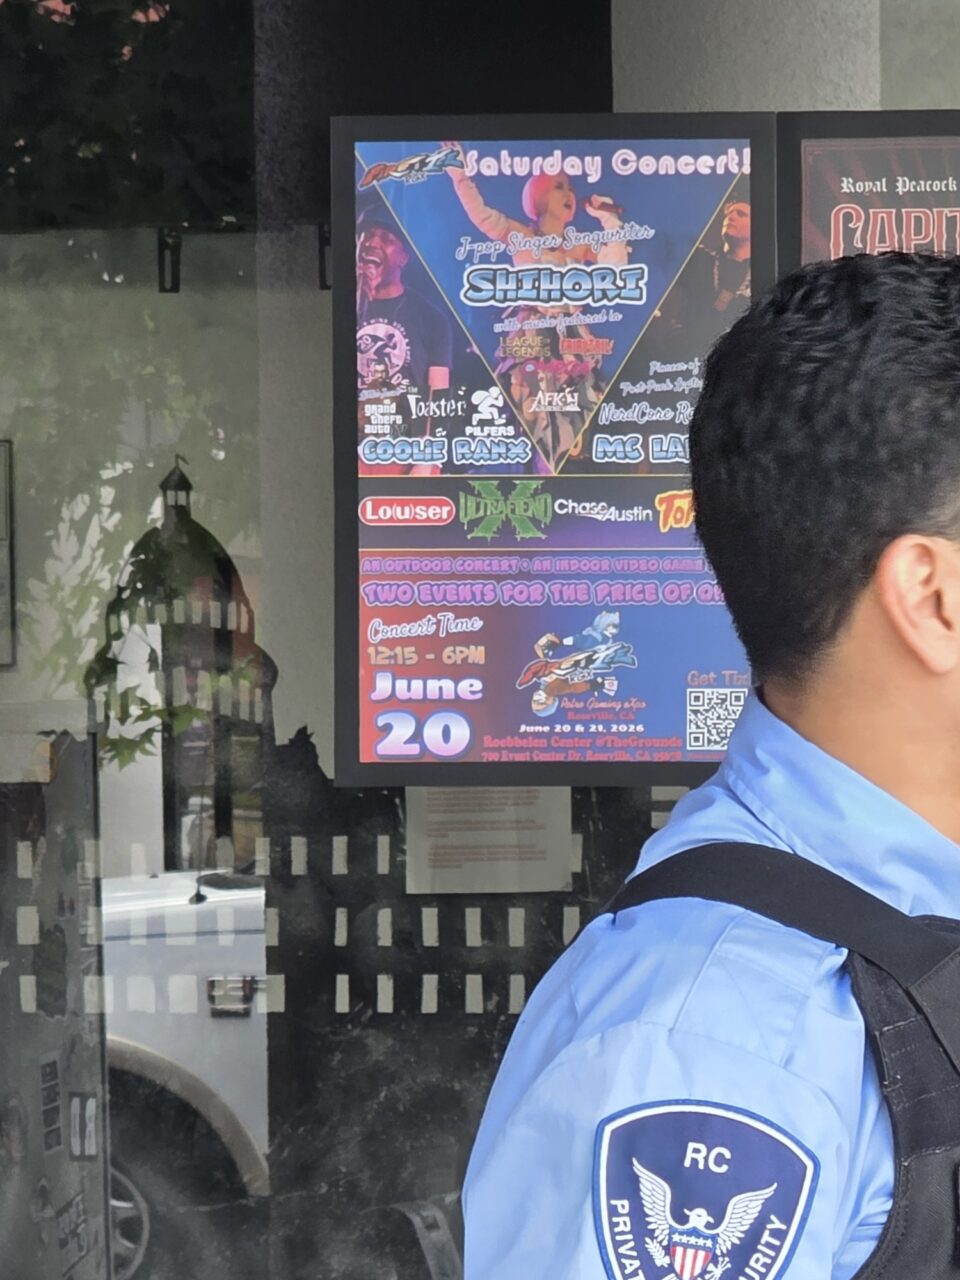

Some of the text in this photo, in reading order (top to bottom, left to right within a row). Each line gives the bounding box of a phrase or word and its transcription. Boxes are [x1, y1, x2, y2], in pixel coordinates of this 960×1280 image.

[463, 149, 601, 183] Saturday
[611, 147, 751, 176] Concert!
[841, 176, 887, 195] Royal
[896, 175, 957, 195] Peacock
[456, 221, 656, 263] J-pop Singer Songwriter
[463, 266, 646, 305] SHIHORI
[500, 337, 543, 347] LEAGUE
[500, 347, 551, 358] LEGENDS
[364, 402, 396, 416] grand
[364, 424, 390, 434] auto
[370, 414, 402, 425] theft
[465, 425, 515, 436] PILFERS
[452, 438, 531, 464] RANX
[594, 434, 690, 463] MC LA
[366, 500, 451, 520] Lo(u)ser
[363, 558, 382, 573] AN
[384, 558, 452, 573] OUTDOOR
[454, 557, 520, 573] CONCERT
[532, 557, 552, 573] AN
[555, 557, 611, 573] INDOOR
[613, 557, 660, 573] VIDEO
[363, 581, 415, 605] TWO
[417, 581, 498, 605] EVENTS
[500, 581, 545, 605] FOR
[547, 581, 592, 605] THE
[594, 581, 660, 605] PRICE
[662, 580, 694, 605] OF
[368, 612, 483, 643] Concert Time
[367, 646, 418, 664] 12:15
[442, 645, 486, 664] 6PM
[370, 671, 484, 701] June
[687, 670, 717, 686] Get
[375, 710, 472, 757] 20
[519, 724, 550, 733] June
[554, 724, 571, 733] 20
[575, 724, 584, 733] &
[611, 724, 645, 733] 2026
[551, 736, 592, 748] Center
[683, 1141, 732, 1174] RC
